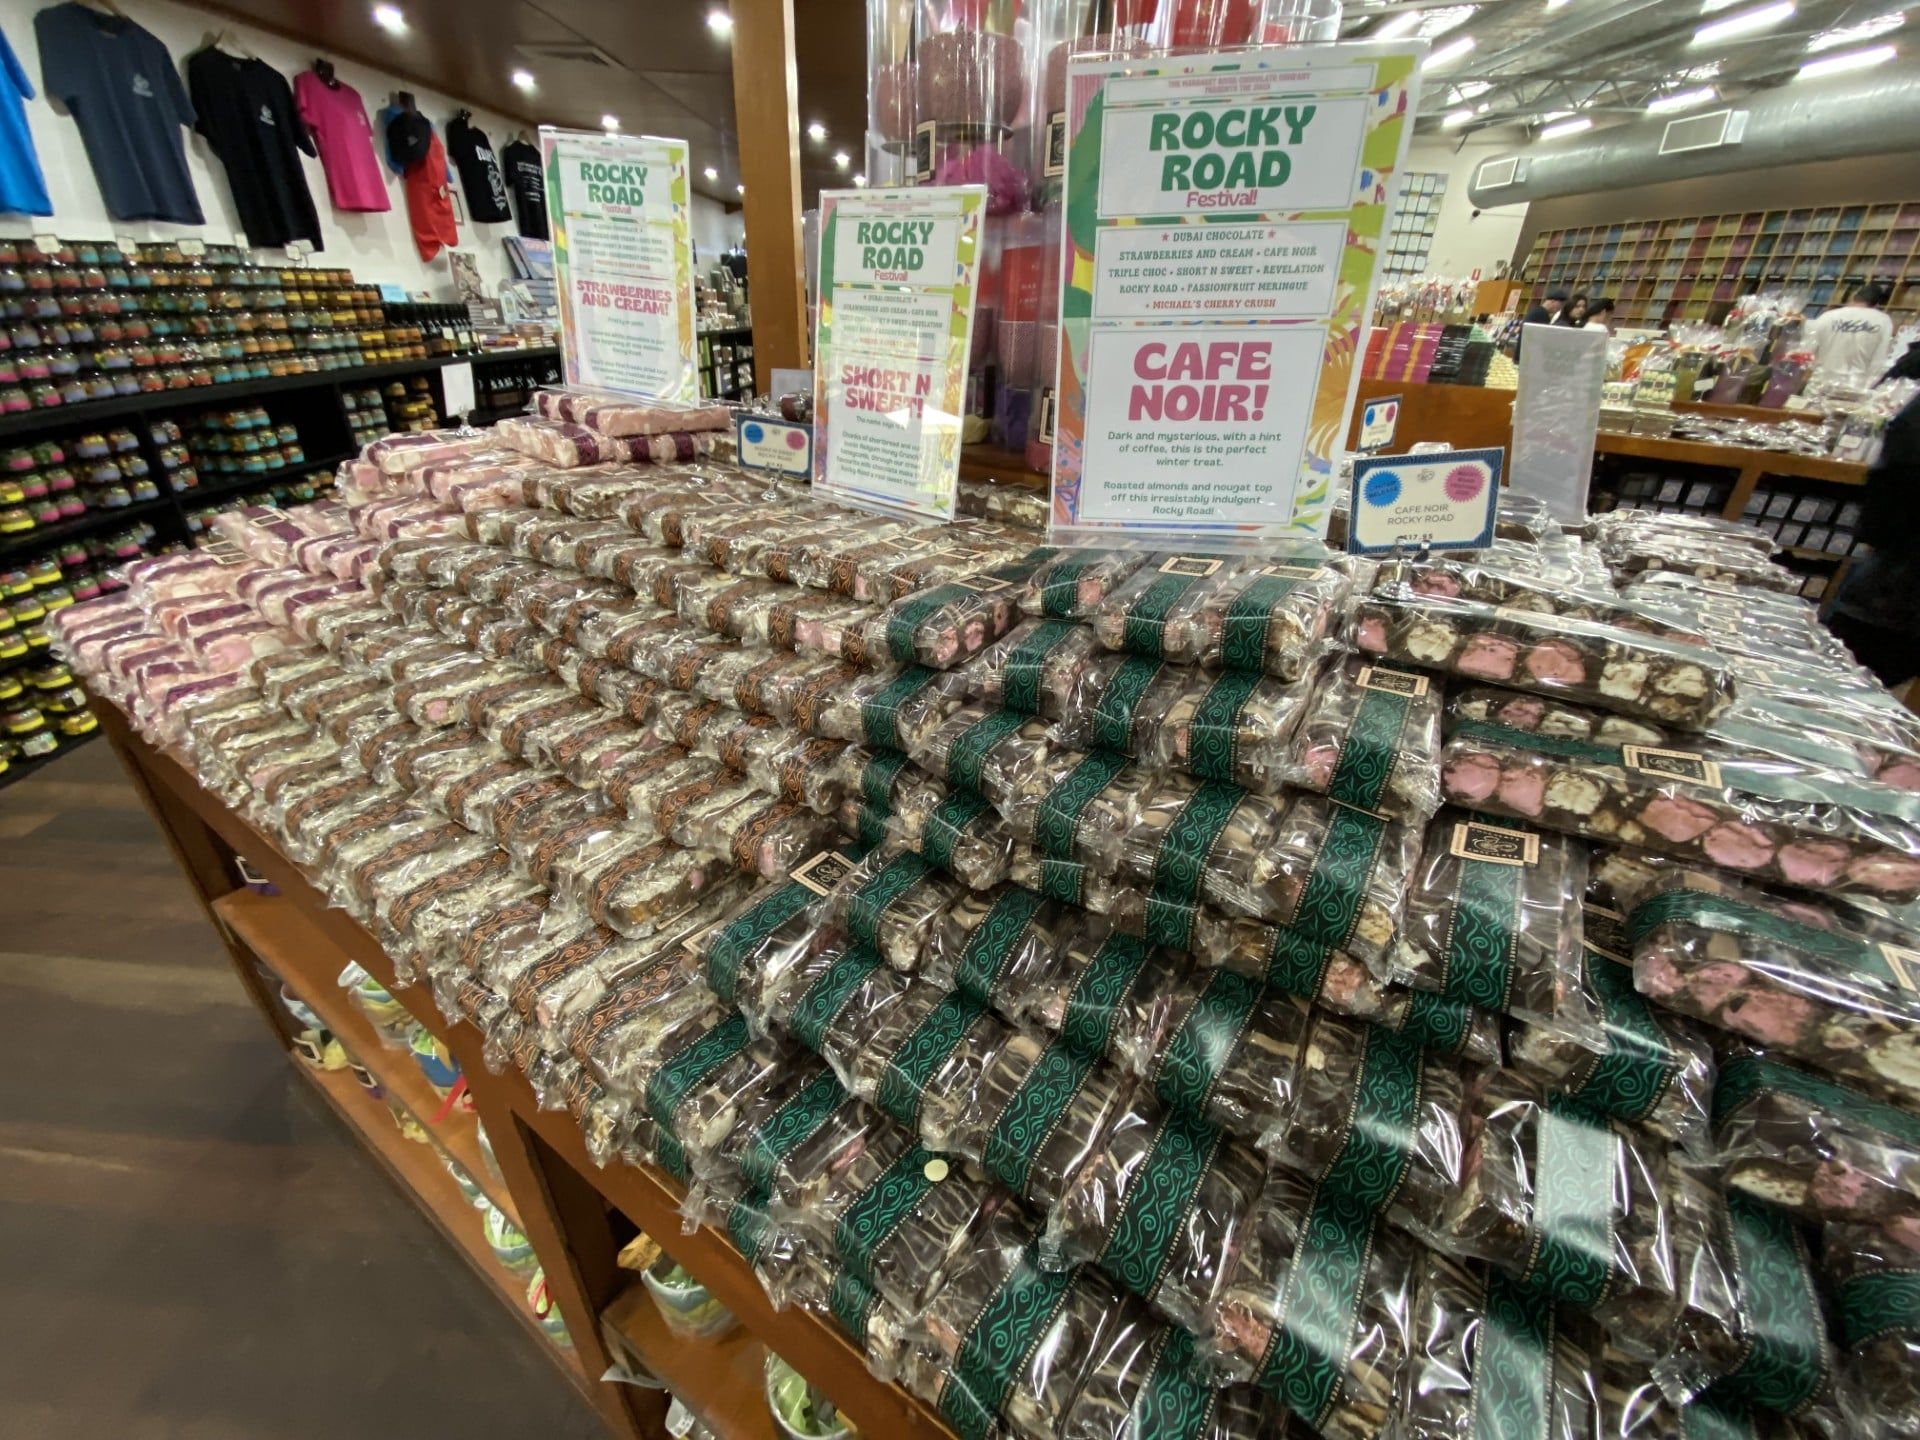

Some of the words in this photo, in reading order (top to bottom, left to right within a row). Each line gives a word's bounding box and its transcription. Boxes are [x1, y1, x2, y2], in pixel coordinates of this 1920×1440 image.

[1149, 105, 1317, 151] ROCKY
[580, 162, 648, 186] ROCKY
[1161, 150, 1291, 191] ROAD
[588, 183, 644, 207] ROAD
[1186, 189, 1258, 208] Festival!
[857, 222, 934, 245] ROCKY
[1173, 232, 1203, 242] DUBAI
[1205, 230, 1264, 241] CHOCOLATE
[862, 246, 924, 271] ROAD
[1119, 249, 1193, 261] STRAWBERRIES
[1196, 249, 1216, 259] AND
[1220, 248, 1254, 258] CREAM
[1263, 247, 1289, 257] CAFE
[1291, 246, 1317, 256] NOIR
[1109, 268, 1139, 278] TRIPLE
[1142, 268, 1167, 277] CHOC
[1176, 267, 1208, 276] SHORT
[1210, 266, 1218, 276] N
[1220, 265, 1254, 275] SWEET
[1263, 264, 1325, 275] REVELATION
[576, 279, 672, 303] STRAWBERRIES
[1119, 284, 1150, 294] ROCKY
[1153, 284, 1178, 293] ROAD
[1187, 282, 1256, 292] PASSIONFRUIT
[1258, 281, 1309, 291] MERINGUE
[582, 292, 611, 308] AND
[614, 297, 669, 317] CREAM!
[1153, 300, 1201, 309] MICHAEL'S
[1204, 299, 1242, 309] CHERRY
[1244, 298, 1276, 308] CRUSH
[1133, 341, 1272, 381] CAFE
[841, 364, 912, 393] SHORT
[915, 373, 931, 396] N
[845, 387, 923, 419] SWEET!
[1128, 384, 1269, 422] NOIR!
[1107, 431, 1133, 440] Dark
[1135, 431, 1155, 440] and
[1157, 432, 1220, 442] mysterious,
[1223, 432, 1246, 441] with
[1250, 433, 1256, 441] a
[1259, 432, 1282, 441] hint
[1119, 444, 1130, 453] of
[1132, 444, 1168, 453] coffee,
[1171, 445, 1190, 453] this
[1193, 445, 1202, 454] is
[1206, 445, 1224, 454] the
[1225, 445, 1267, 455] perfect
[1156, 457, 1190, 466] winter
[1193, 458, 1224, 466] treat.
[1103, 481, 1145, 490] Roasted
[1147, 482, 1189, 491] almonds
[1191, 483, 1211, 491] and
[1213, 484, 1251, 493] nougat
[1254, 484, 1273, 493] top
[1111, 493, 1126, 502] off
[1129, 494, 1148, 502] this
[1211, 495, 1261, 506] indulgent
[1152, 506, 1184, 517] Rocky
[1186, 506, 1214, 515] Road!
[1394, 505, 1422, 514] CAFE
[1424, 503, 1449, 513] NOIR
[1387, 515, 1422, 525] ROCKY
[1425, 514, 1454, 523] ROAD
